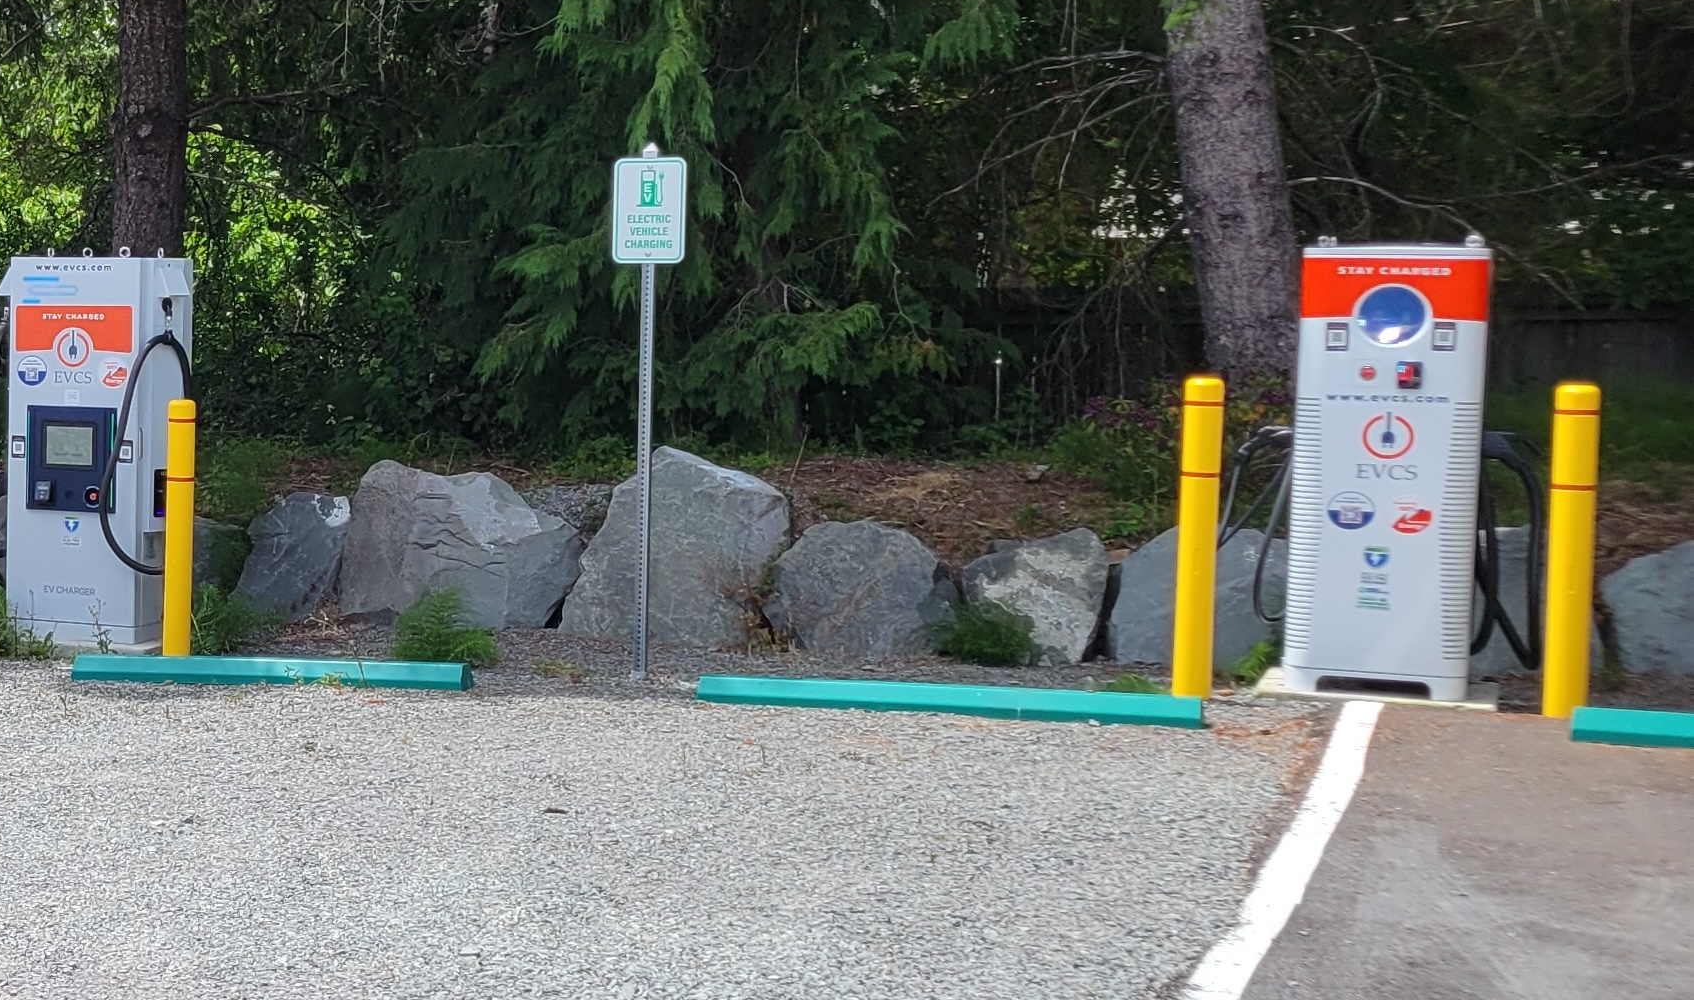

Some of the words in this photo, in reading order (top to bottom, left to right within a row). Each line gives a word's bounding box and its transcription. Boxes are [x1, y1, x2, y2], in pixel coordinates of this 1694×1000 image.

[627, 214, 671, 223] ELECTRIC
[629, 226, 669, 236] VEHICLE
[624, 239, 673, 249] CHARGING
[35, 263, 112, 272] www.evcs.com
[1336, 265, 1374, 275] STAY
[1378, 266, 1453, 276] CHARGED
[53, 370, 93, 384] EVCS
[1325, 394, 1451, 404] www.evcs.com
[1355, 463, 1419, 481] EVCS
[43, 585, 55, 594] EV
[56, 585, 96, 596] CHARGER
